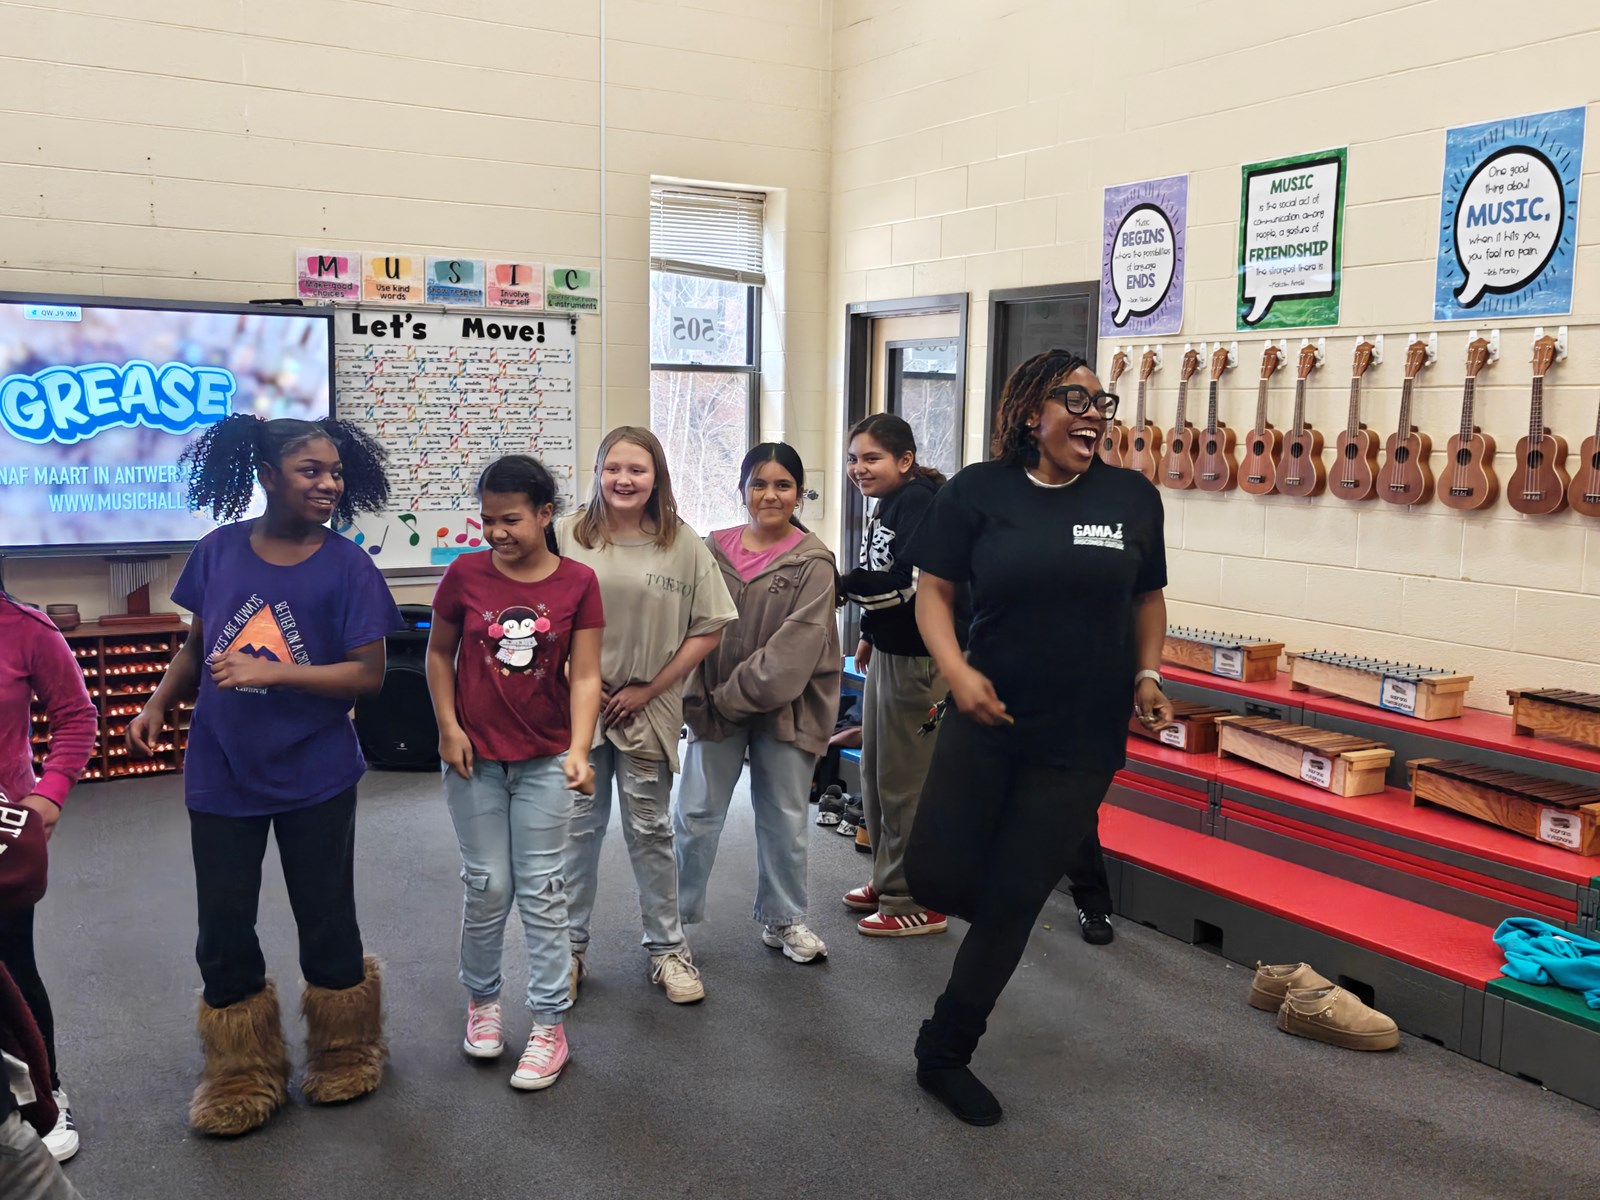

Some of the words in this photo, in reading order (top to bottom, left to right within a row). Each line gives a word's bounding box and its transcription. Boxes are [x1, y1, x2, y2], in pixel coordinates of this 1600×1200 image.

[1489, 166, 1506, 178] One
[1510, 162, 1529, 177] good
[1270, 174, 1314, 194] MUSIC
[1485, 182, 1504, 194] thing
[1507, 178, 1530, 192] about
[1466, 196, 1550, 228] MUSIC.
[1122, 228, 1165, 247] BEGINS
[1469, 234, 1493, 245] when
[1249, 240, 1328, 262] FRIENDSHIP
[1504, 249, 1515, 257] no
[1126, 273, 1155, 289] ENDS
[352, 313, 426, 340] Let's
[462, 317, 545, 343] Move!
[2, 362, 234, 440] GREASE
[34, 466, 89, 485] MAART
[94, 466, 109, 484] IN
[1073, 524, 1112, 537] GAMA
[223, 620, 239, 640] ARE
[234, 593, 263, 626] ALWAYS
[275, 601, 296, 631] BETTER
[287, 630, 301, 644] ON
[292, 644, 304, 652] A
